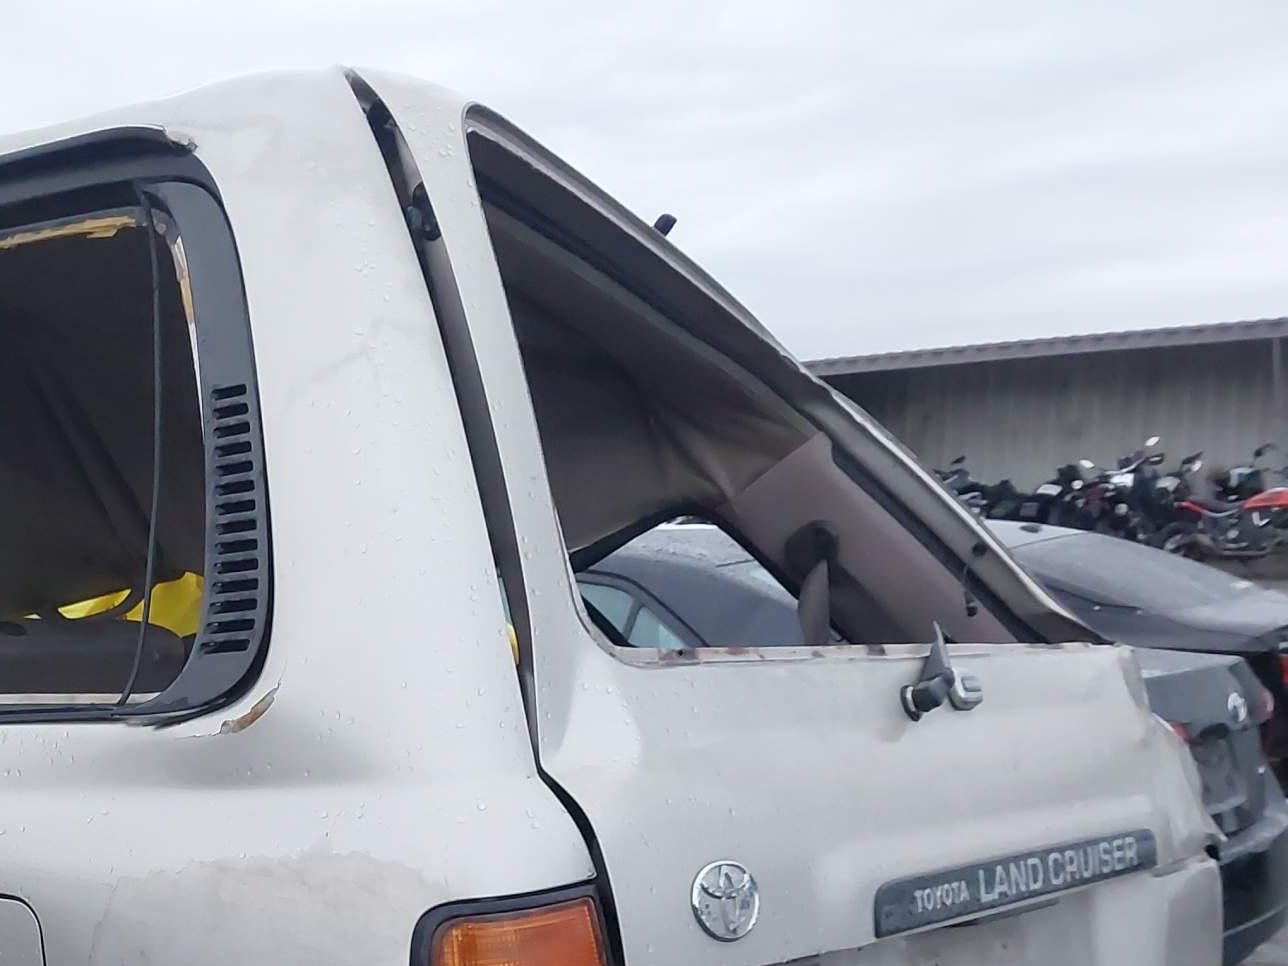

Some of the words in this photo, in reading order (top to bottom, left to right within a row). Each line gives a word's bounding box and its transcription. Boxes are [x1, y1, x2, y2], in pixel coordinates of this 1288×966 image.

[914, 880, 970, 913] TOYOTA
[978, 857, 1044, 904] LAND
[1048, 836, 1139, 886] CRUISER
